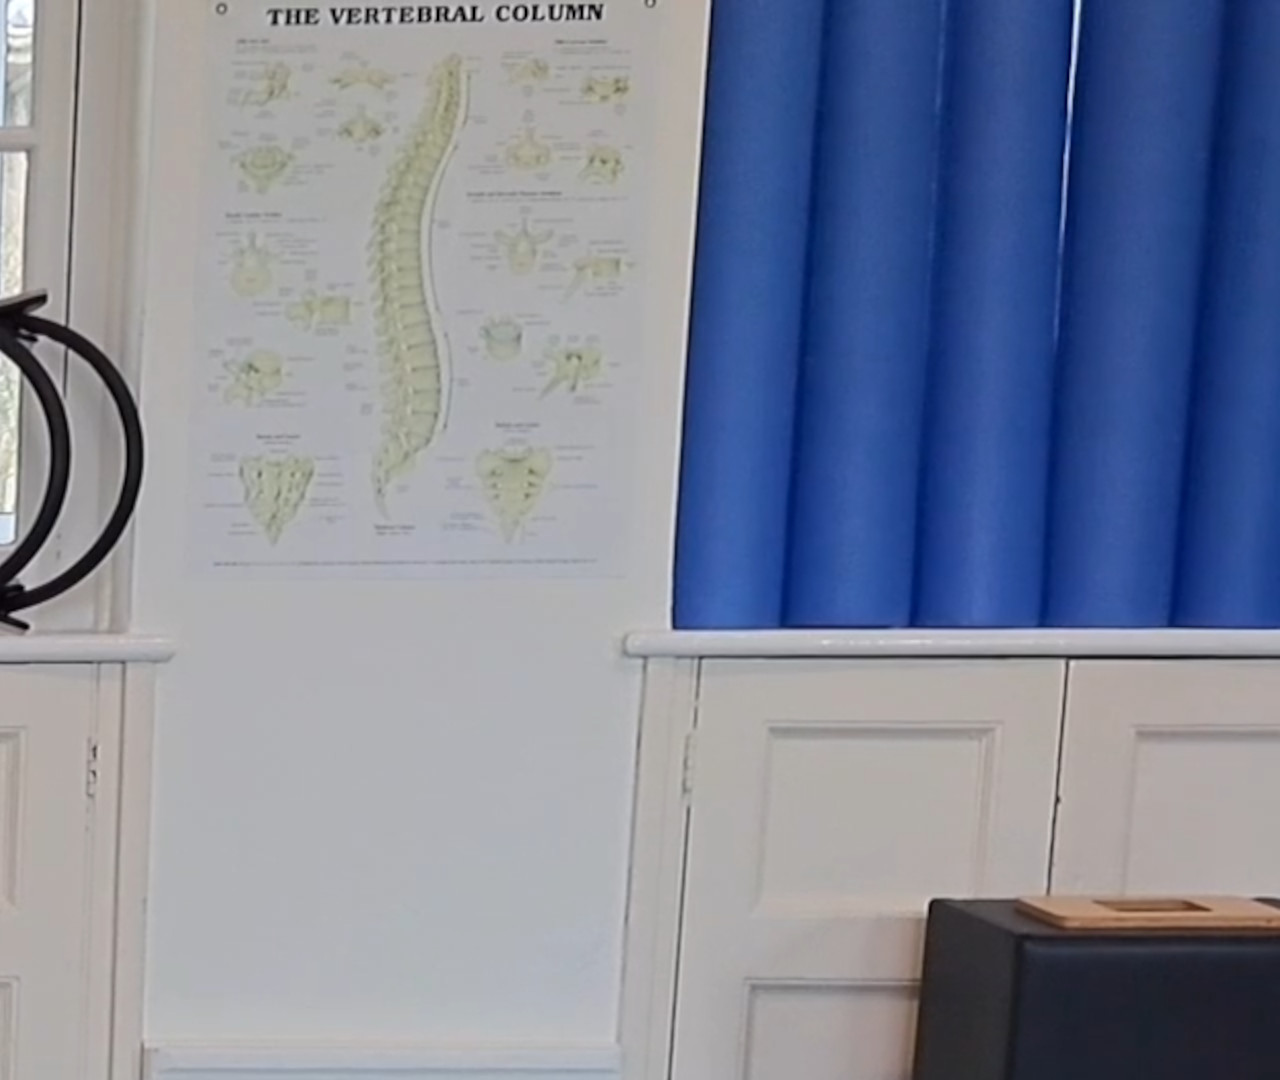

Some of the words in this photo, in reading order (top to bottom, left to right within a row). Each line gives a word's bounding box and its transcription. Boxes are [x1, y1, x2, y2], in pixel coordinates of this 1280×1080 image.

[266, 7, 320, 27] THE
[330, 5, 484, 26] VERTEBRAL
[495, 3, 604, 23] COLUMN
